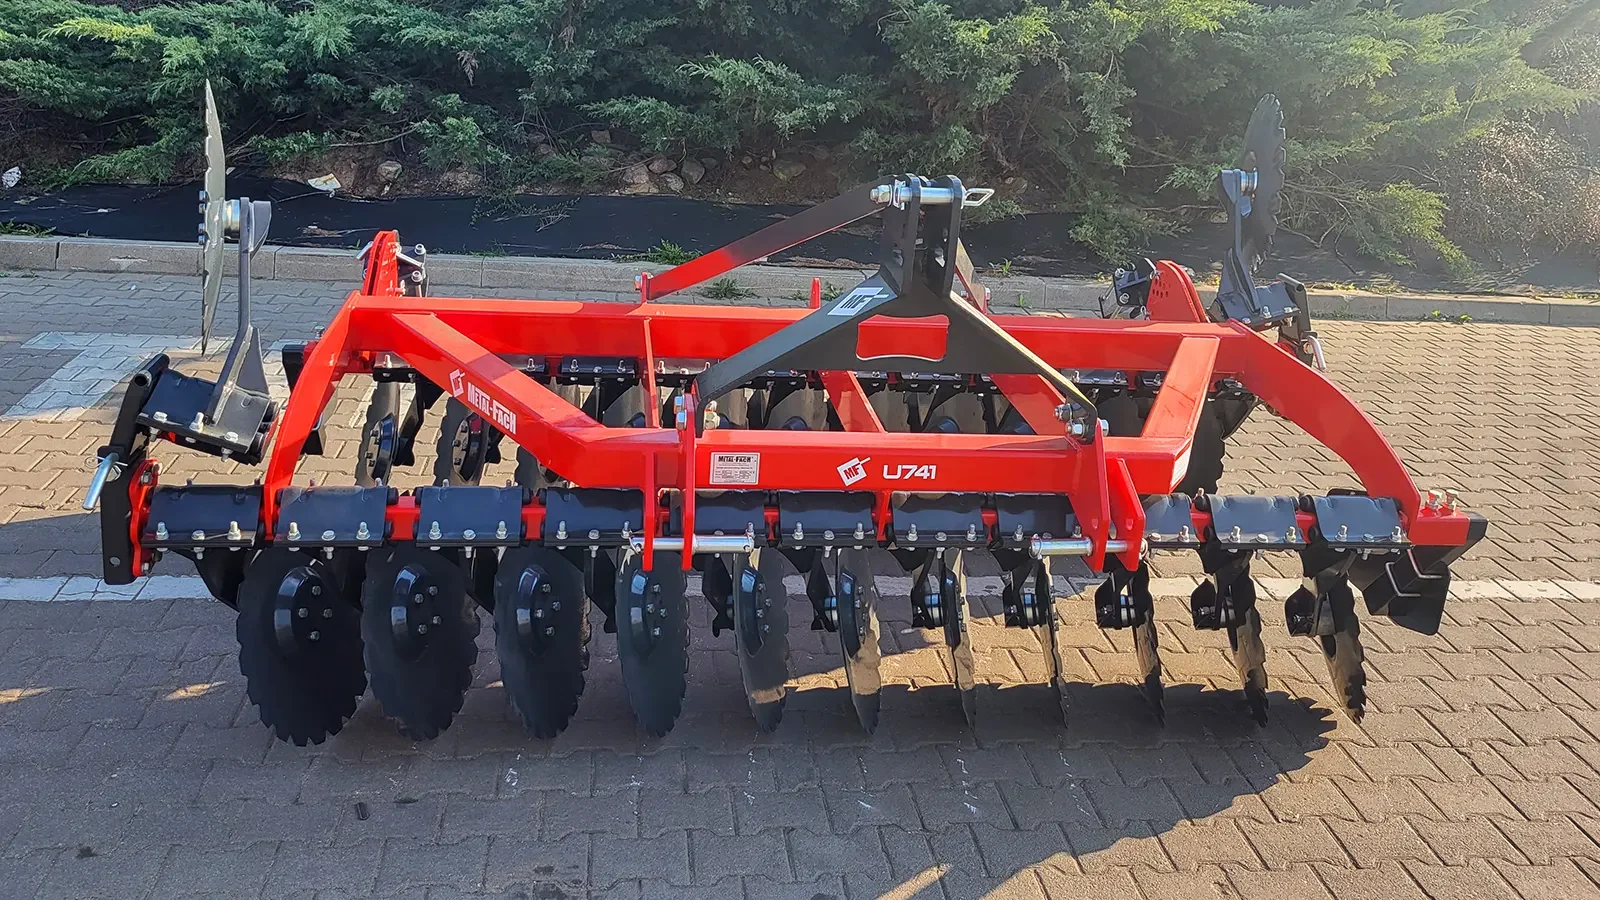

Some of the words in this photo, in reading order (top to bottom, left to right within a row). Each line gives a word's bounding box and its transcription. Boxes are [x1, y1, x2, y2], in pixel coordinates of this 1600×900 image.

[840, 294, 875, 309] MF
[467, 381, 517, 435] METAL-FACH
[843, 462, 860, 480] MF
[883, 464, 937, 480] U741
